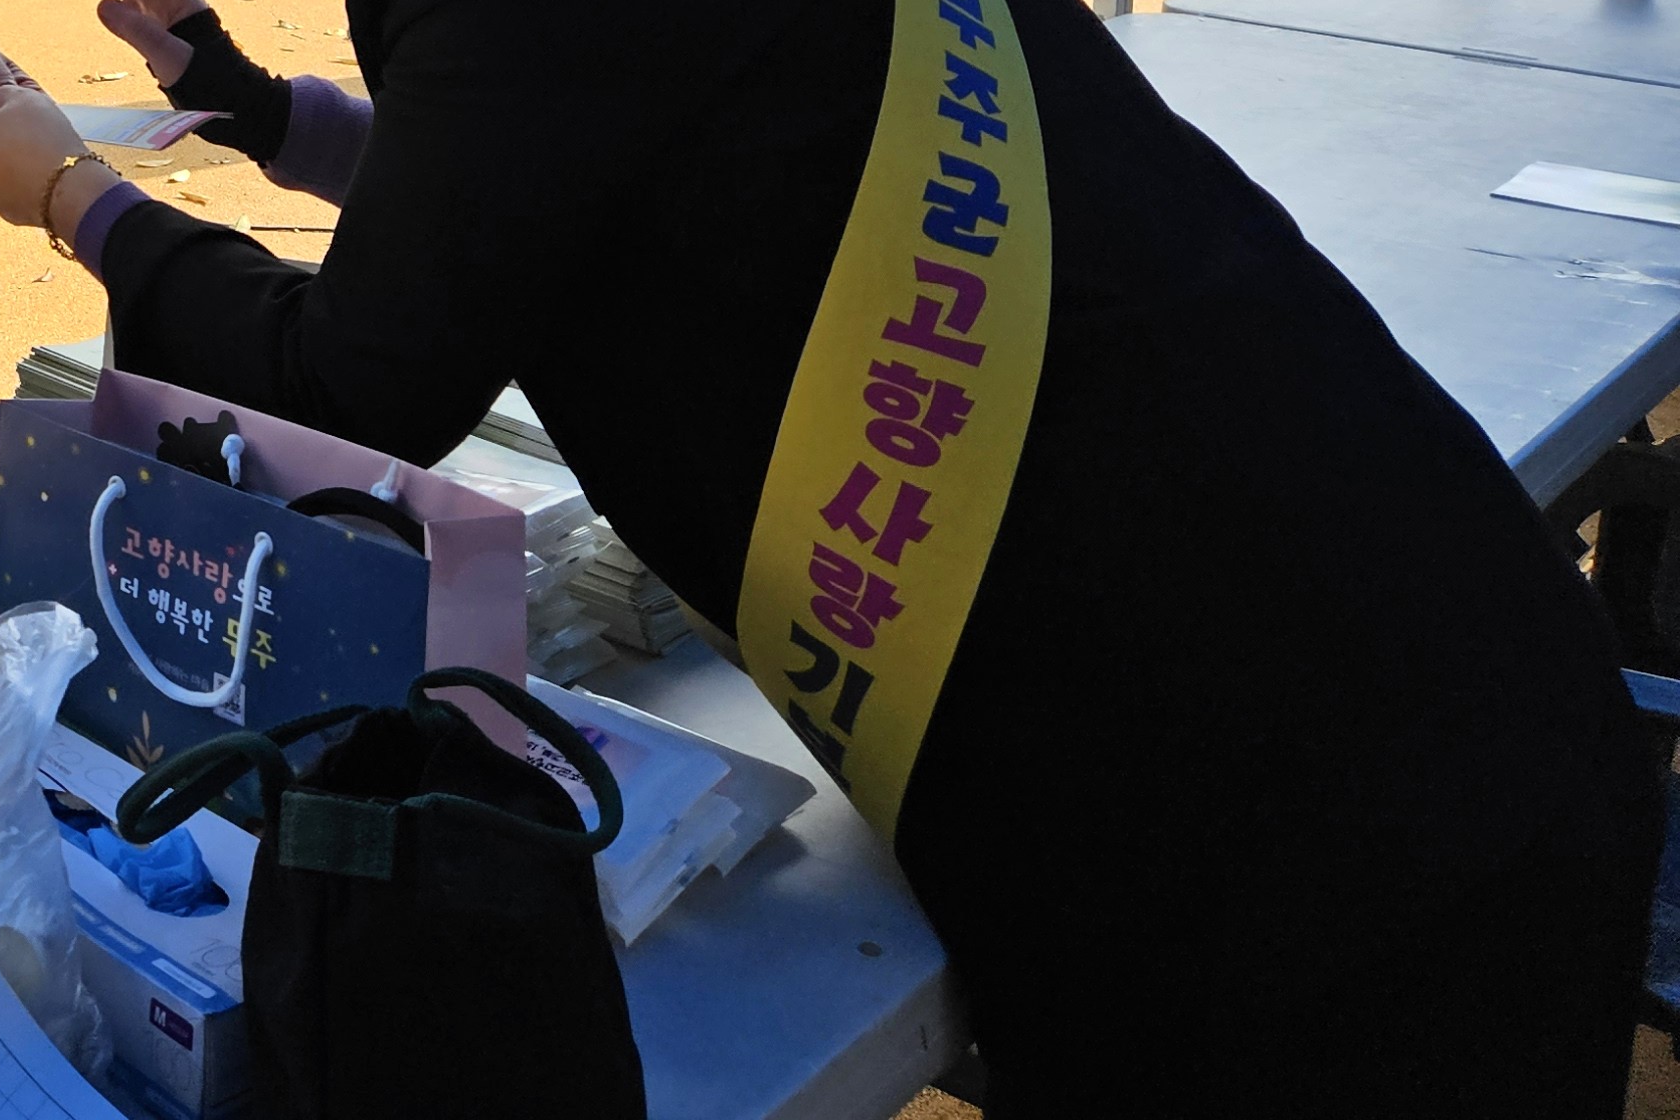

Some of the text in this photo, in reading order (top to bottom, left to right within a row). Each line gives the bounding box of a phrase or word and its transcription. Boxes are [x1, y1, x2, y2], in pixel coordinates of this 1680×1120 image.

[120, 526, 275, 616] 고향사랑으로
[120, 576, 277, 670] 더 행복한 무주
